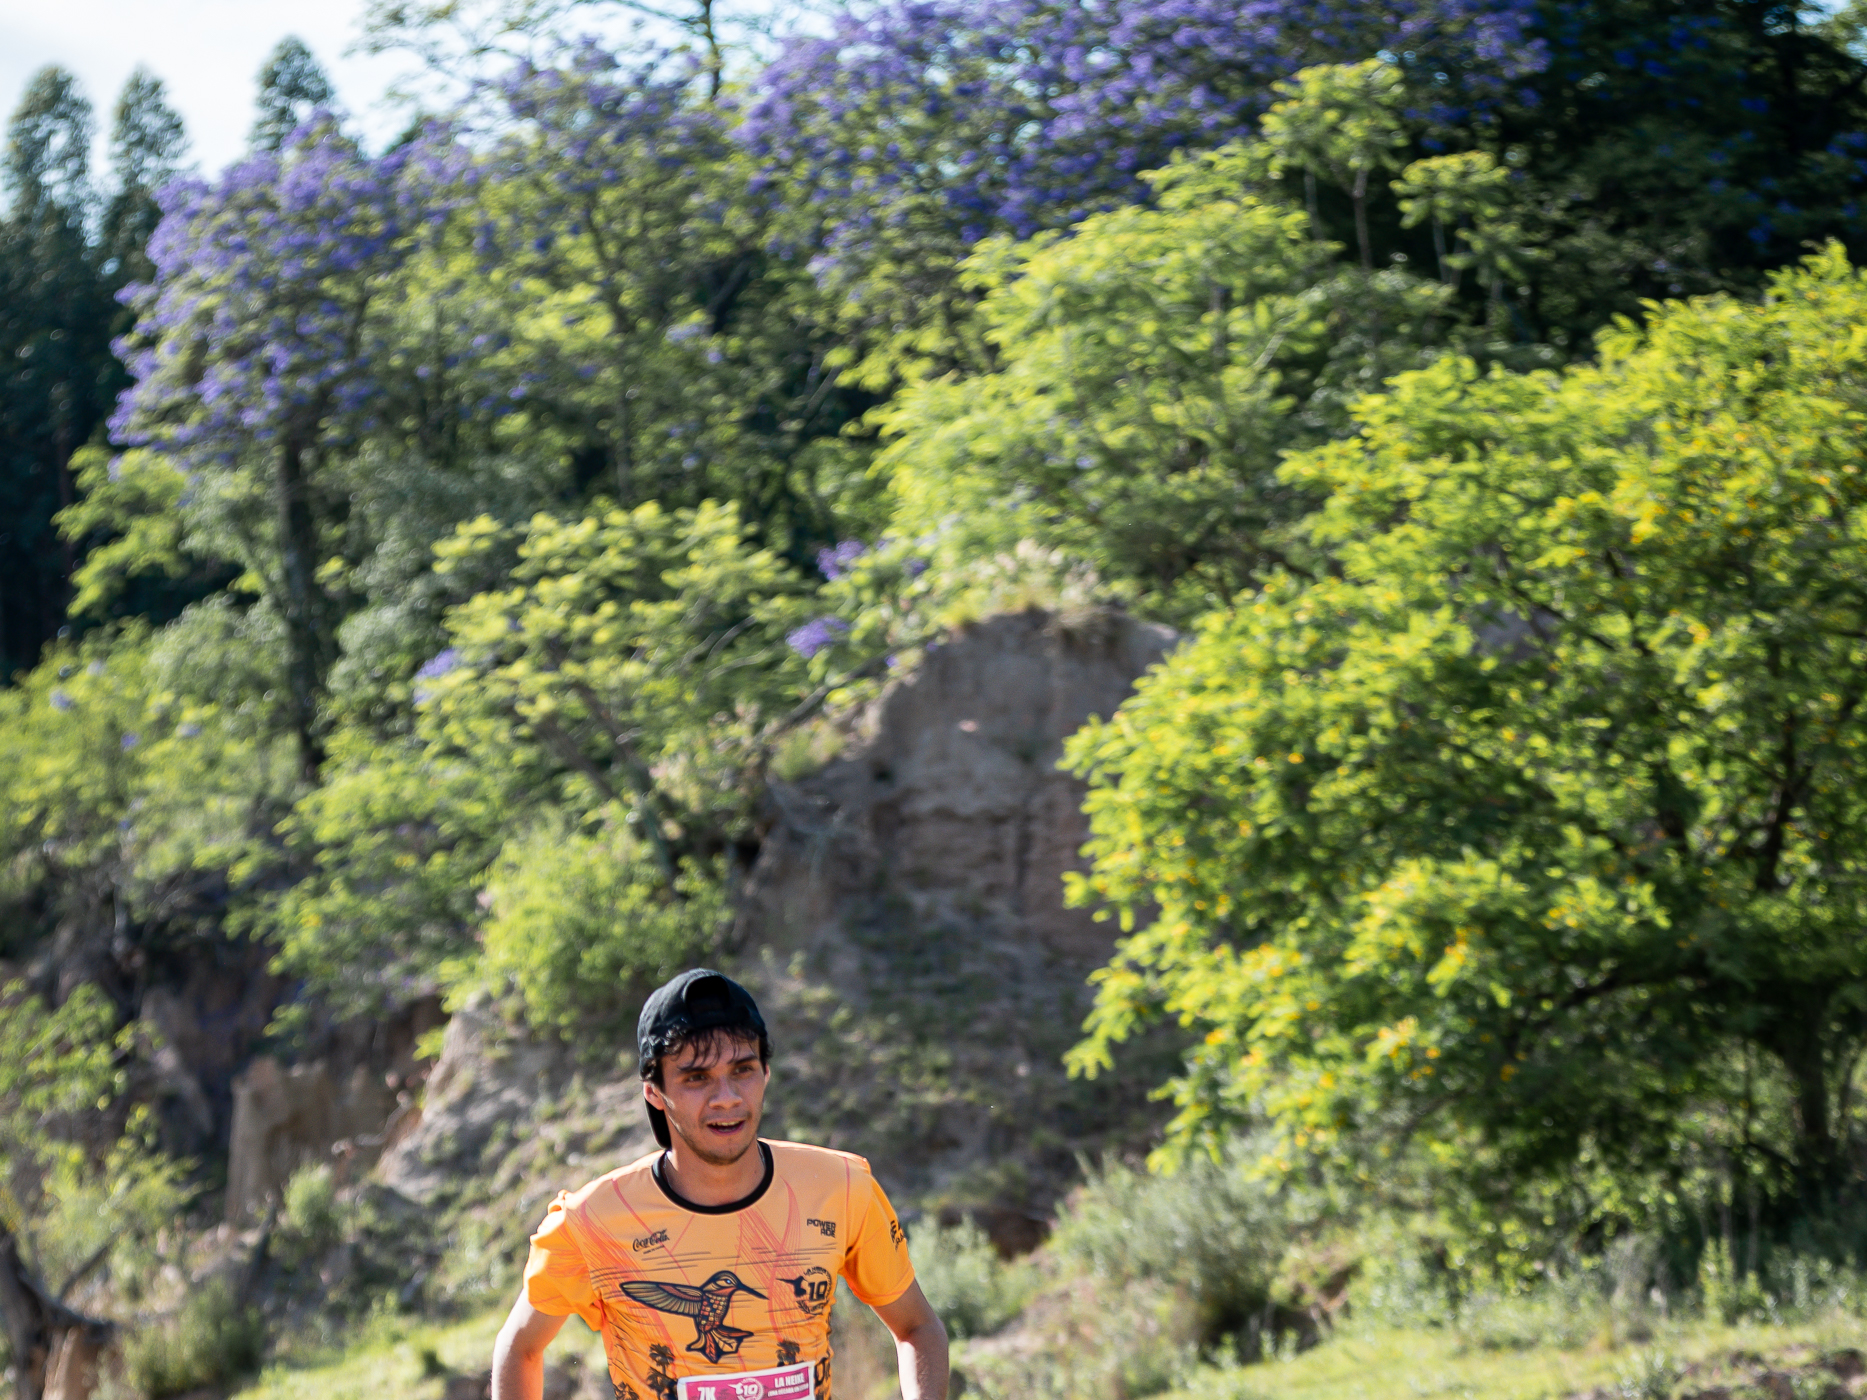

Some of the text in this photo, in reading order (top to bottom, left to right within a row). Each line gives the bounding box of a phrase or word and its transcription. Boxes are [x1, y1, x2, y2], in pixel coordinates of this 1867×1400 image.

[807, 1280, 828, 1302] 10
[774, 1377, 785, 1389] LA
[743, 1384, 758, 1397] 10
